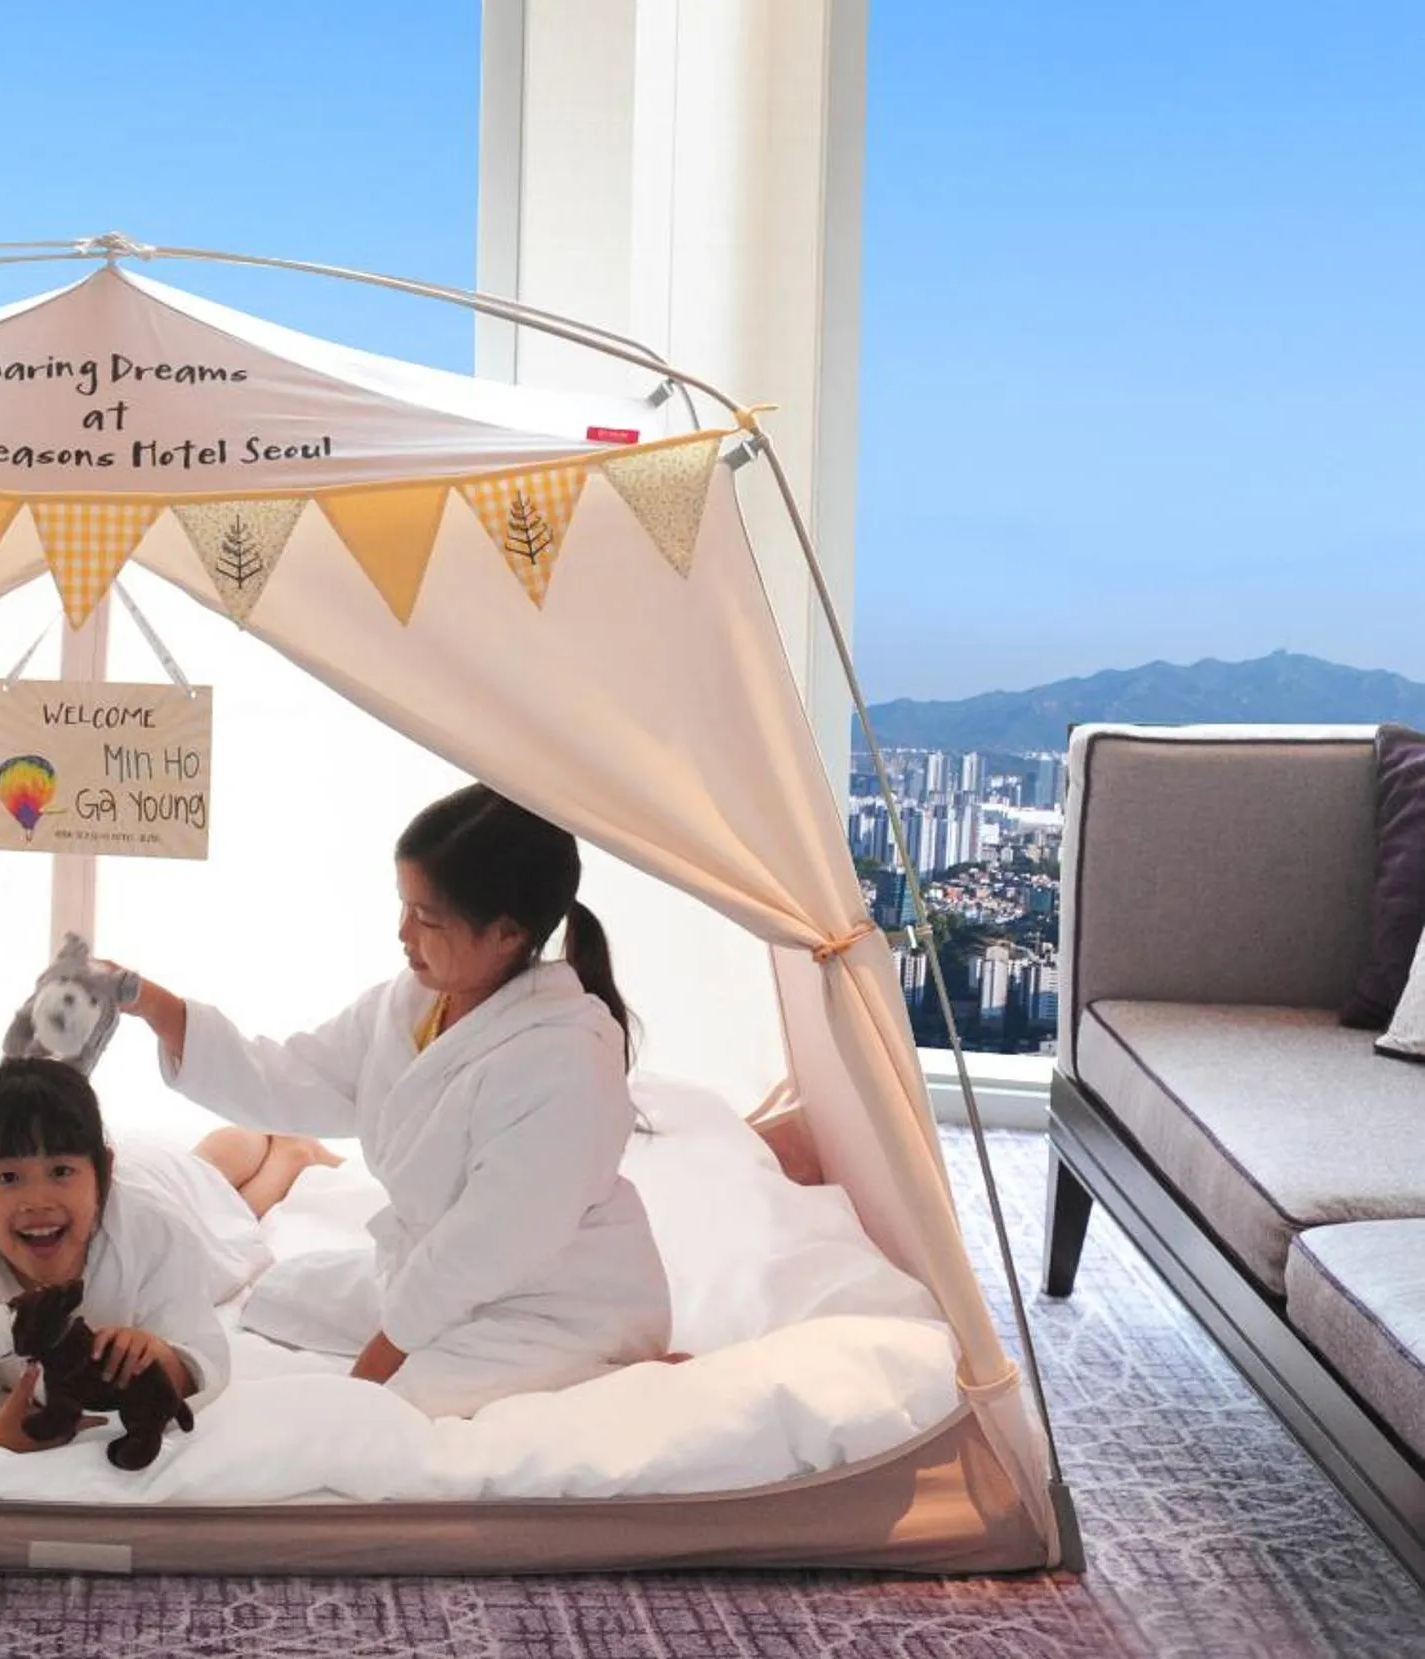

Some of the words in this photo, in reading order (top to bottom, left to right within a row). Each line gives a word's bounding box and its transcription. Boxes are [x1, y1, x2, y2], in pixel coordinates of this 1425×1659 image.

[111, 353, 248, 384] Dreams
[82, 401, 130, 431] at
[132, 440, 227, 469] Hotel
[240, 436, 331, 464] Seoul
[43, 702, 157, 729] WELCOME
